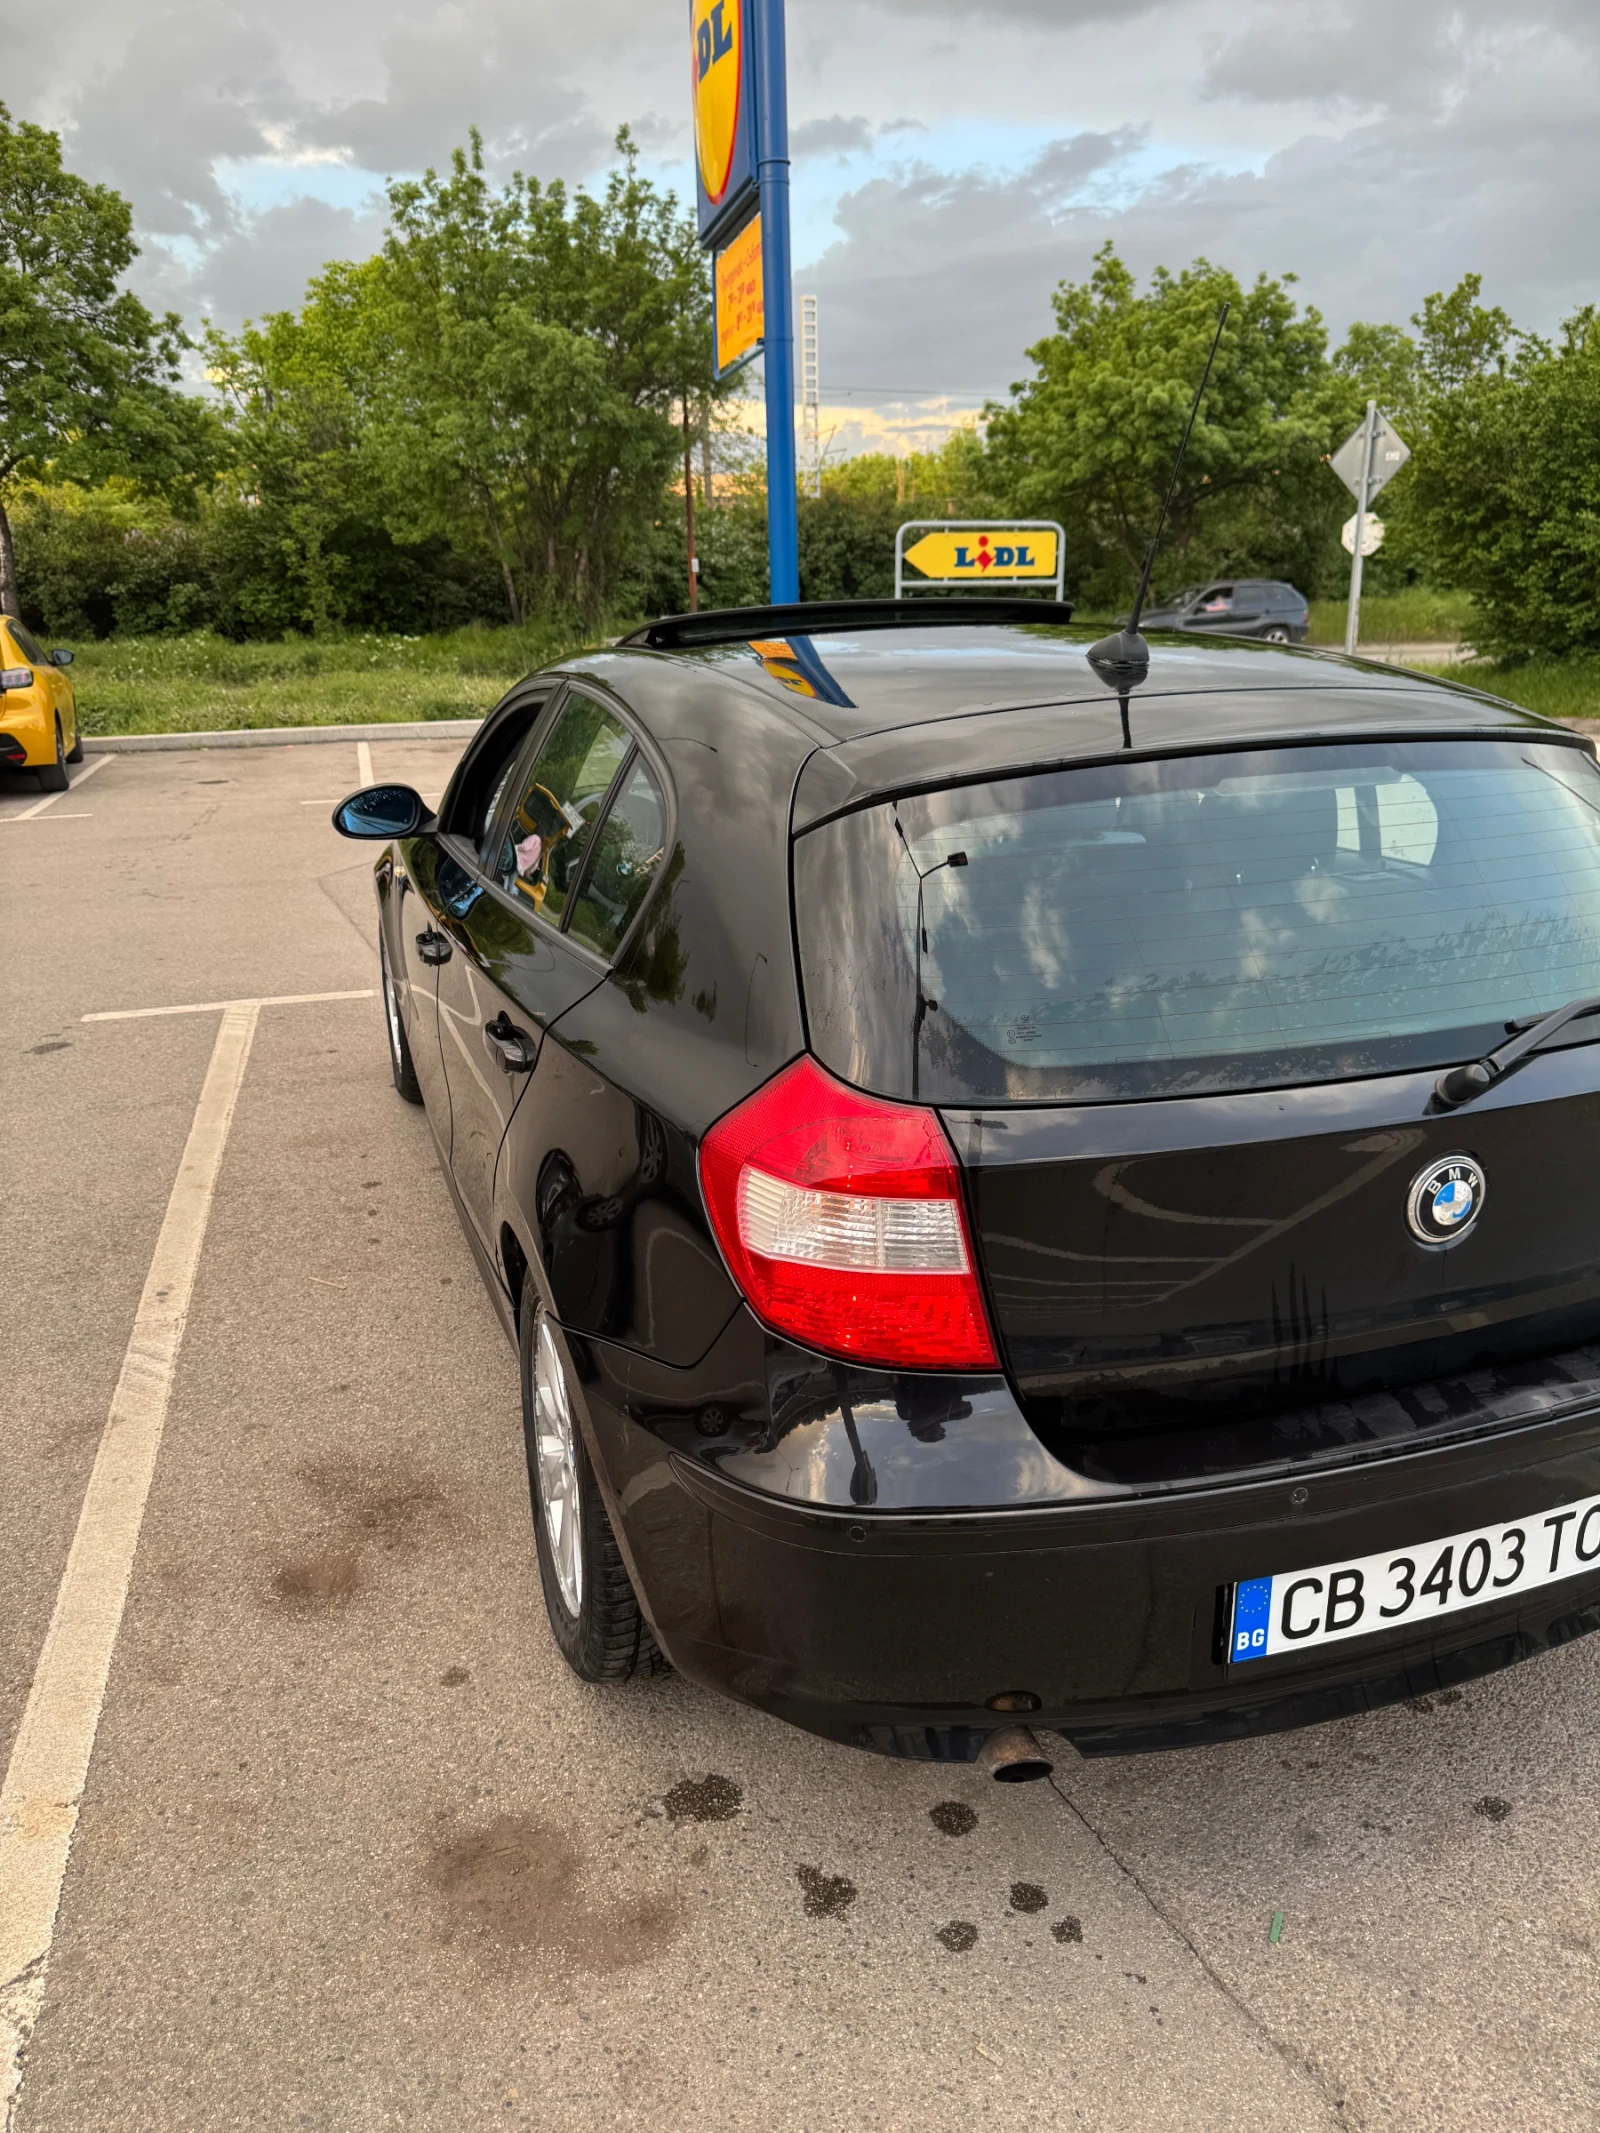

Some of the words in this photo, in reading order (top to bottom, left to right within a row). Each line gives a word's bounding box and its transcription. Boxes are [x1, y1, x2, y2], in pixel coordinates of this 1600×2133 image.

[693, 0, 733, 84] DL
[954, 536, 1035, 572] LIDL
[1427, 1167, 1478, 1195] BMW
[1281, 1568, 1365, 1640] CB
[1379, 1528, 1526, 1618] 3403
[1236, 1628, 1265, 1651] BG
